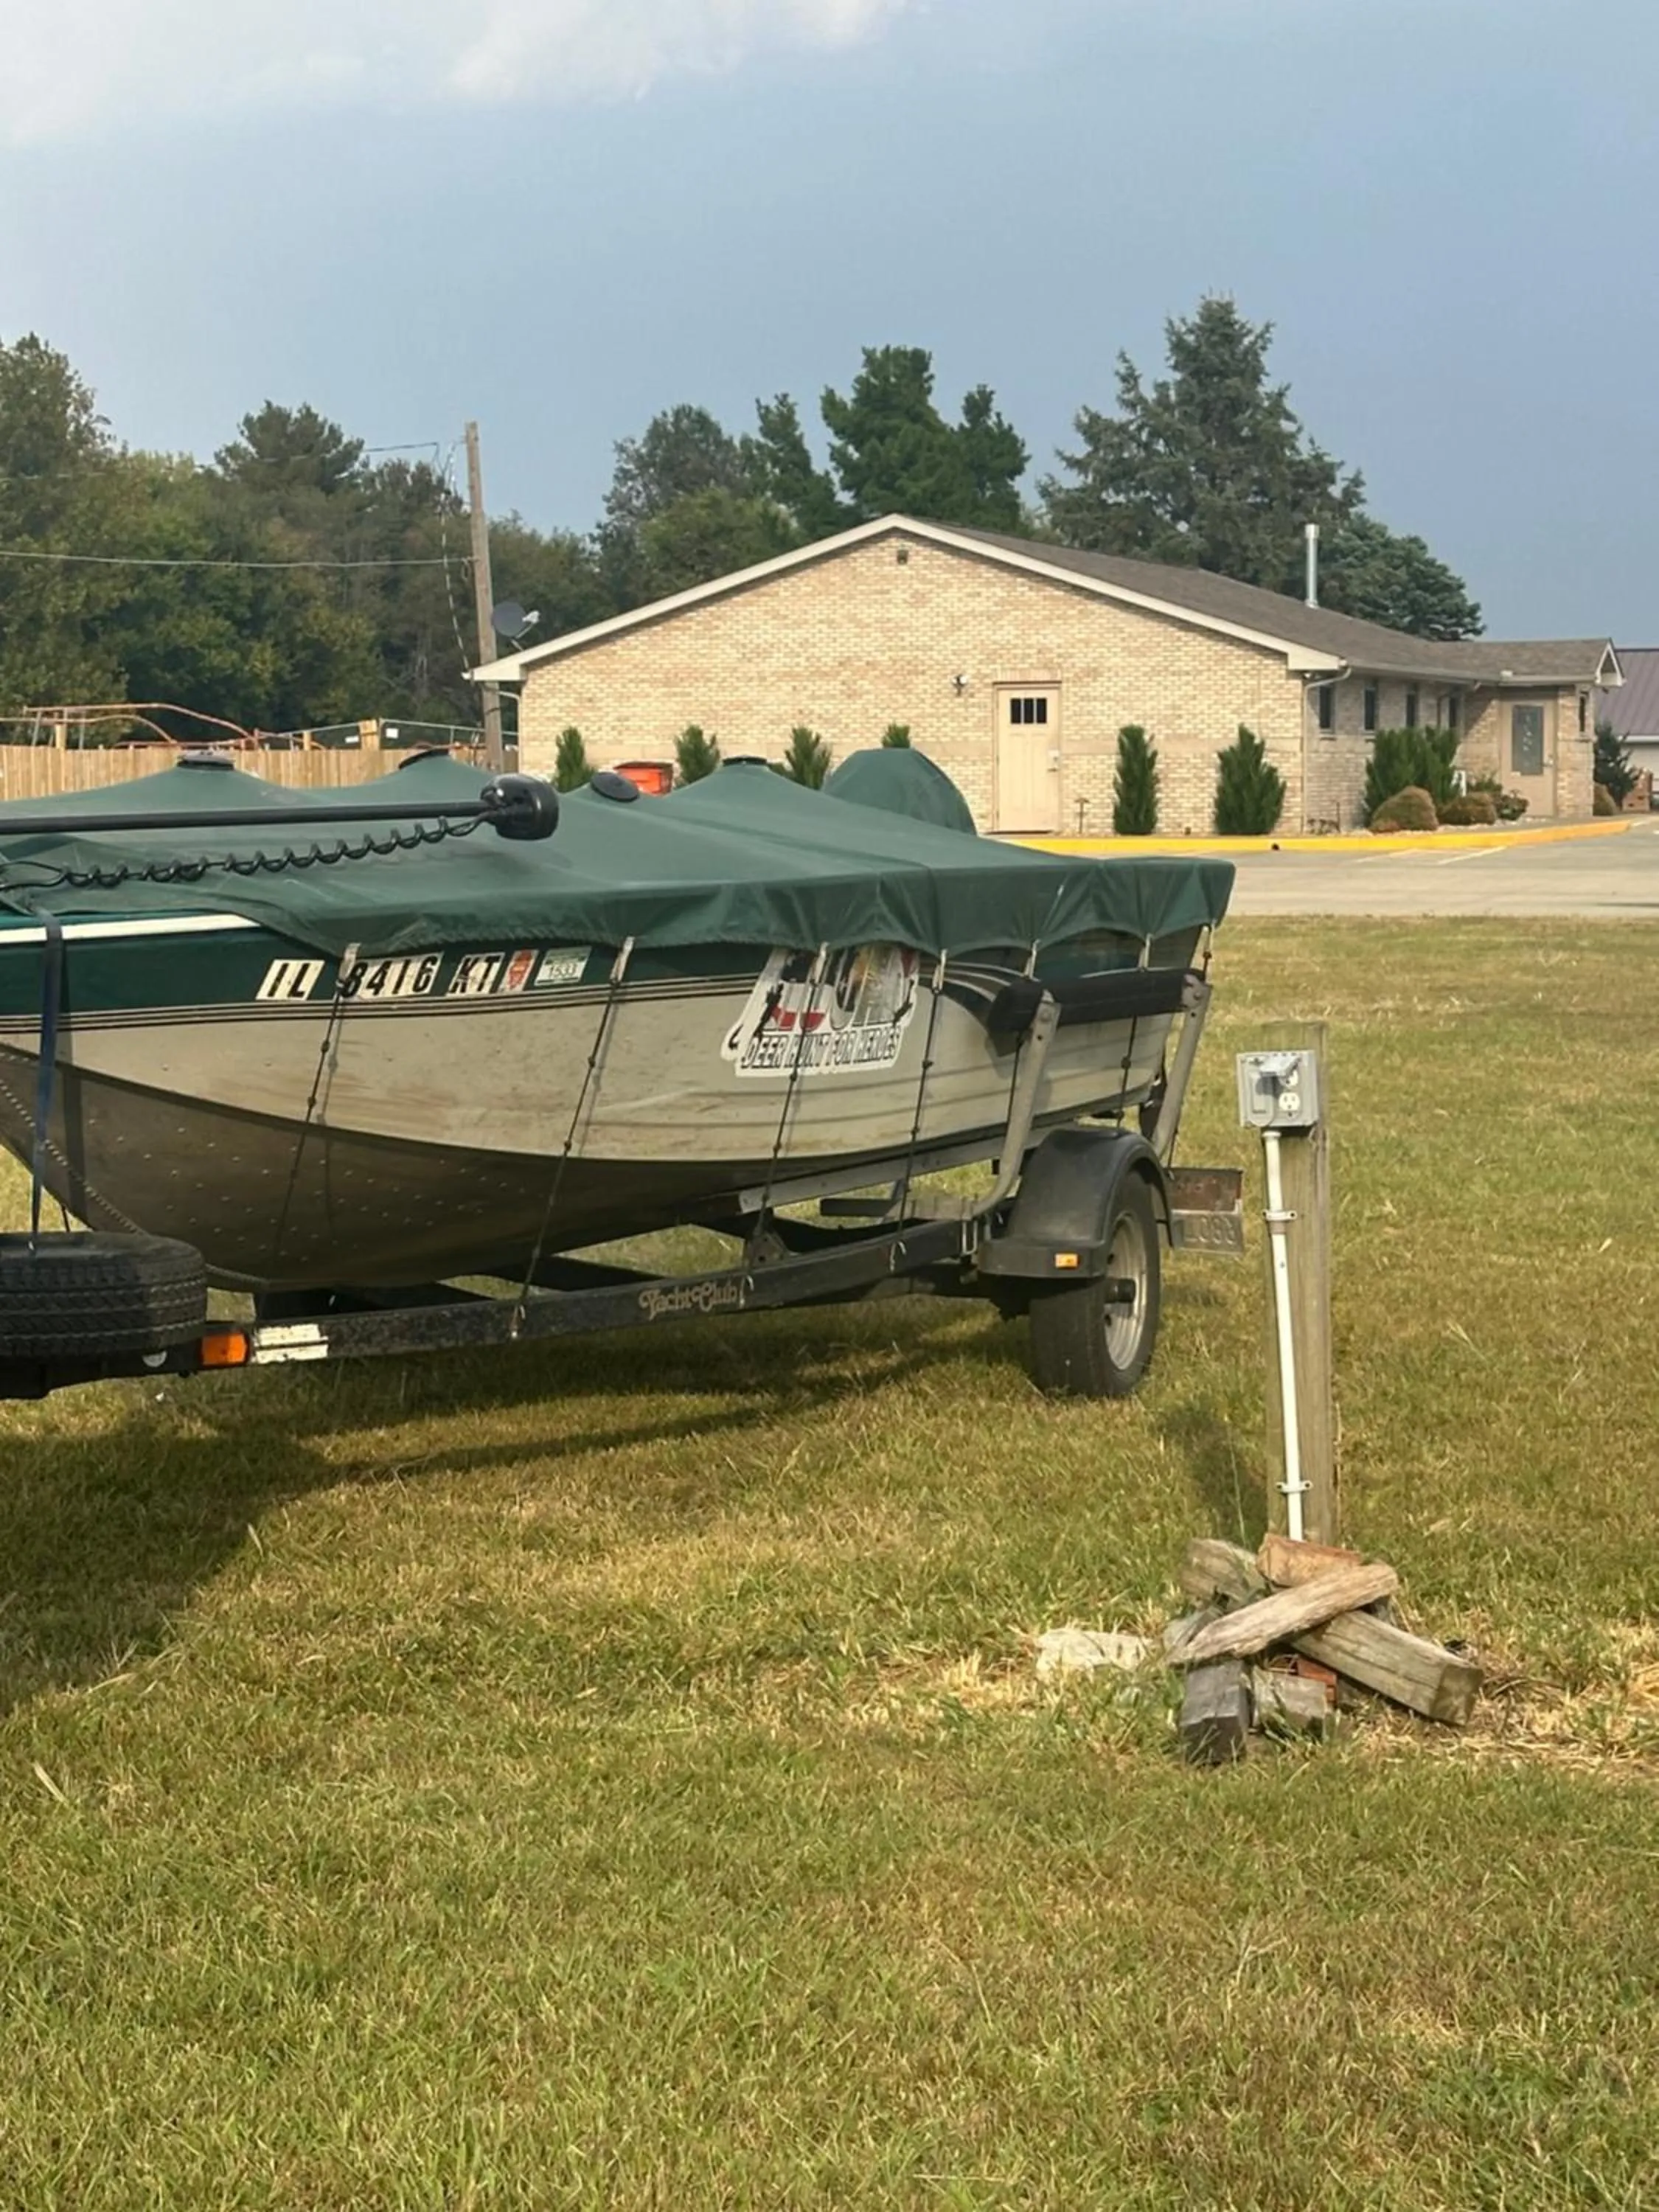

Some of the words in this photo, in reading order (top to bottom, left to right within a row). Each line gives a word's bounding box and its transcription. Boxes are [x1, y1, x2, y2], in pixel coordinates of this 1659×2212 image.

[267, 962, 311, 998] IL
[340, 956, 438, 998] 8416
[449, 956, 501, 994] KT
[740, 1034, 790, 1068] DEER
[826, 1031, 858, 1066] FOR
[638, 1286, 693, 1322] Yacht
[690, 1278, 738, 1313] Club
